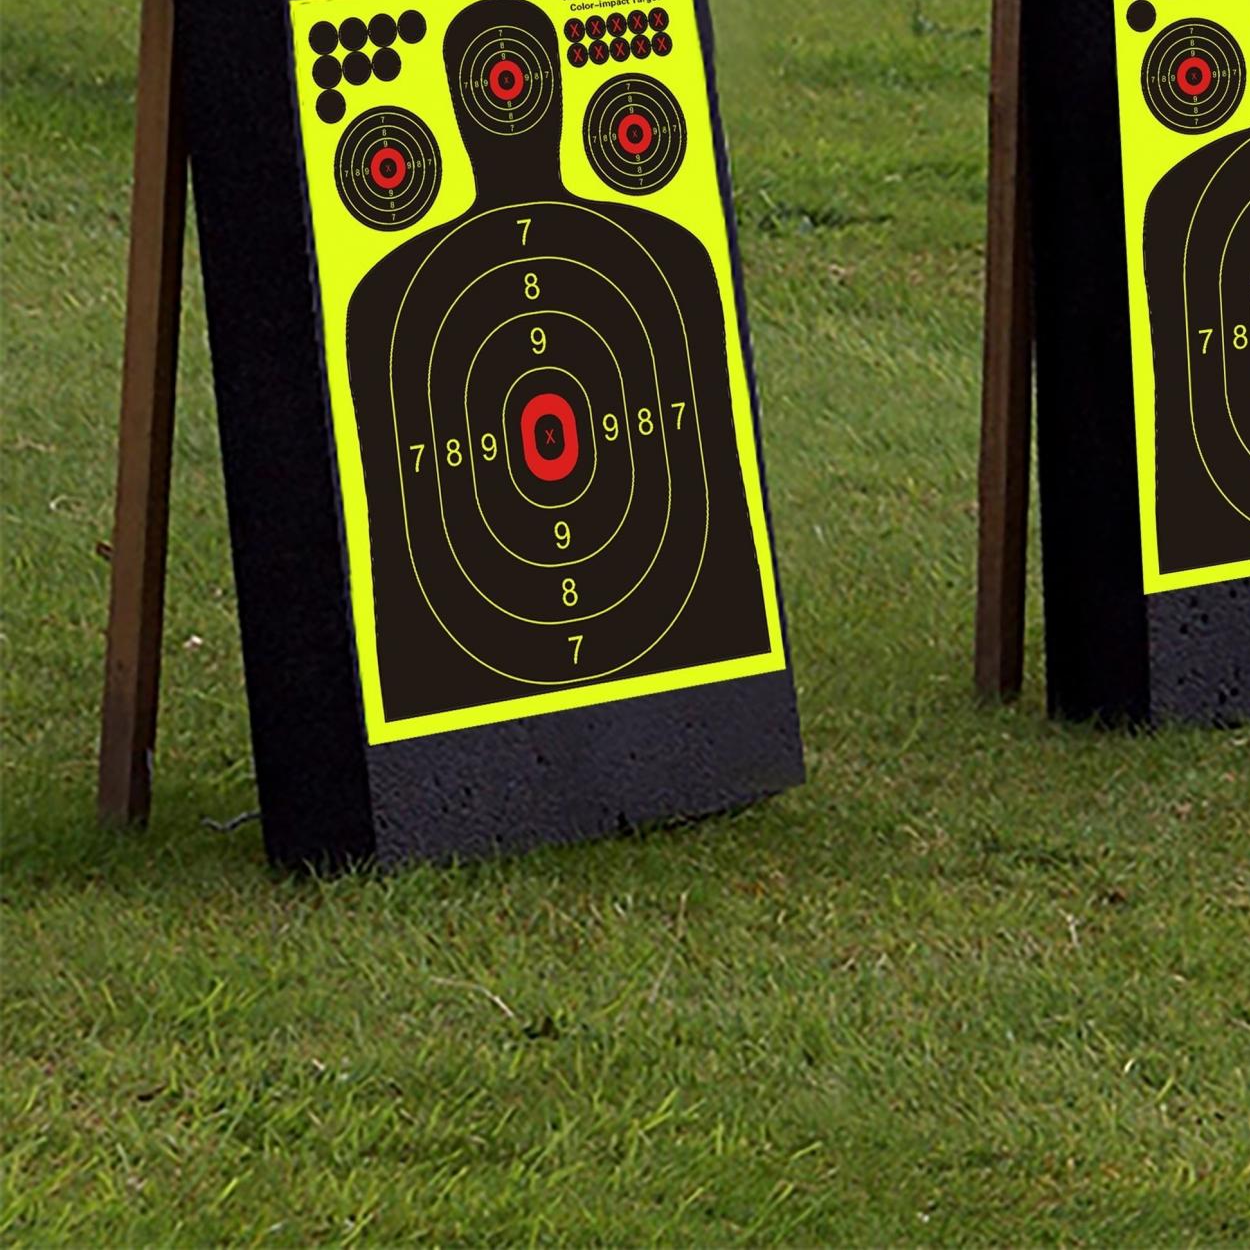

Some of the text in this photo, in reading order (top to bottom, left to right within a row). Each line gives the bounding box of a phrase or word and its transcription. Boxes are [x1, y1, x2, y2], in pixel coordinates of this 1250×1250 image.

[570, 13, 663, 38] X X X X X
[573, 37, 667, 63] X X X X X
[517, 219, 532, 246] 7
[524, 273, 540, 300] 8
[530, 327, 547, 354] 9
[1198, 329, 1213, 354] 7
[1233, 325, 1248, 349] 8
[410, 444, 425, 473] 7
[446, 439, 463, 467] 8
[481, 433, 497, 461] 9
[602, 414, 619, 441] 9
[637, 408, 654, 436] 8
[671, 403, 686, 430] 7
[554, 522, 570, 549] 9
[562, 578, 578, 606] 8
[568, 635, 583, 664] 7
